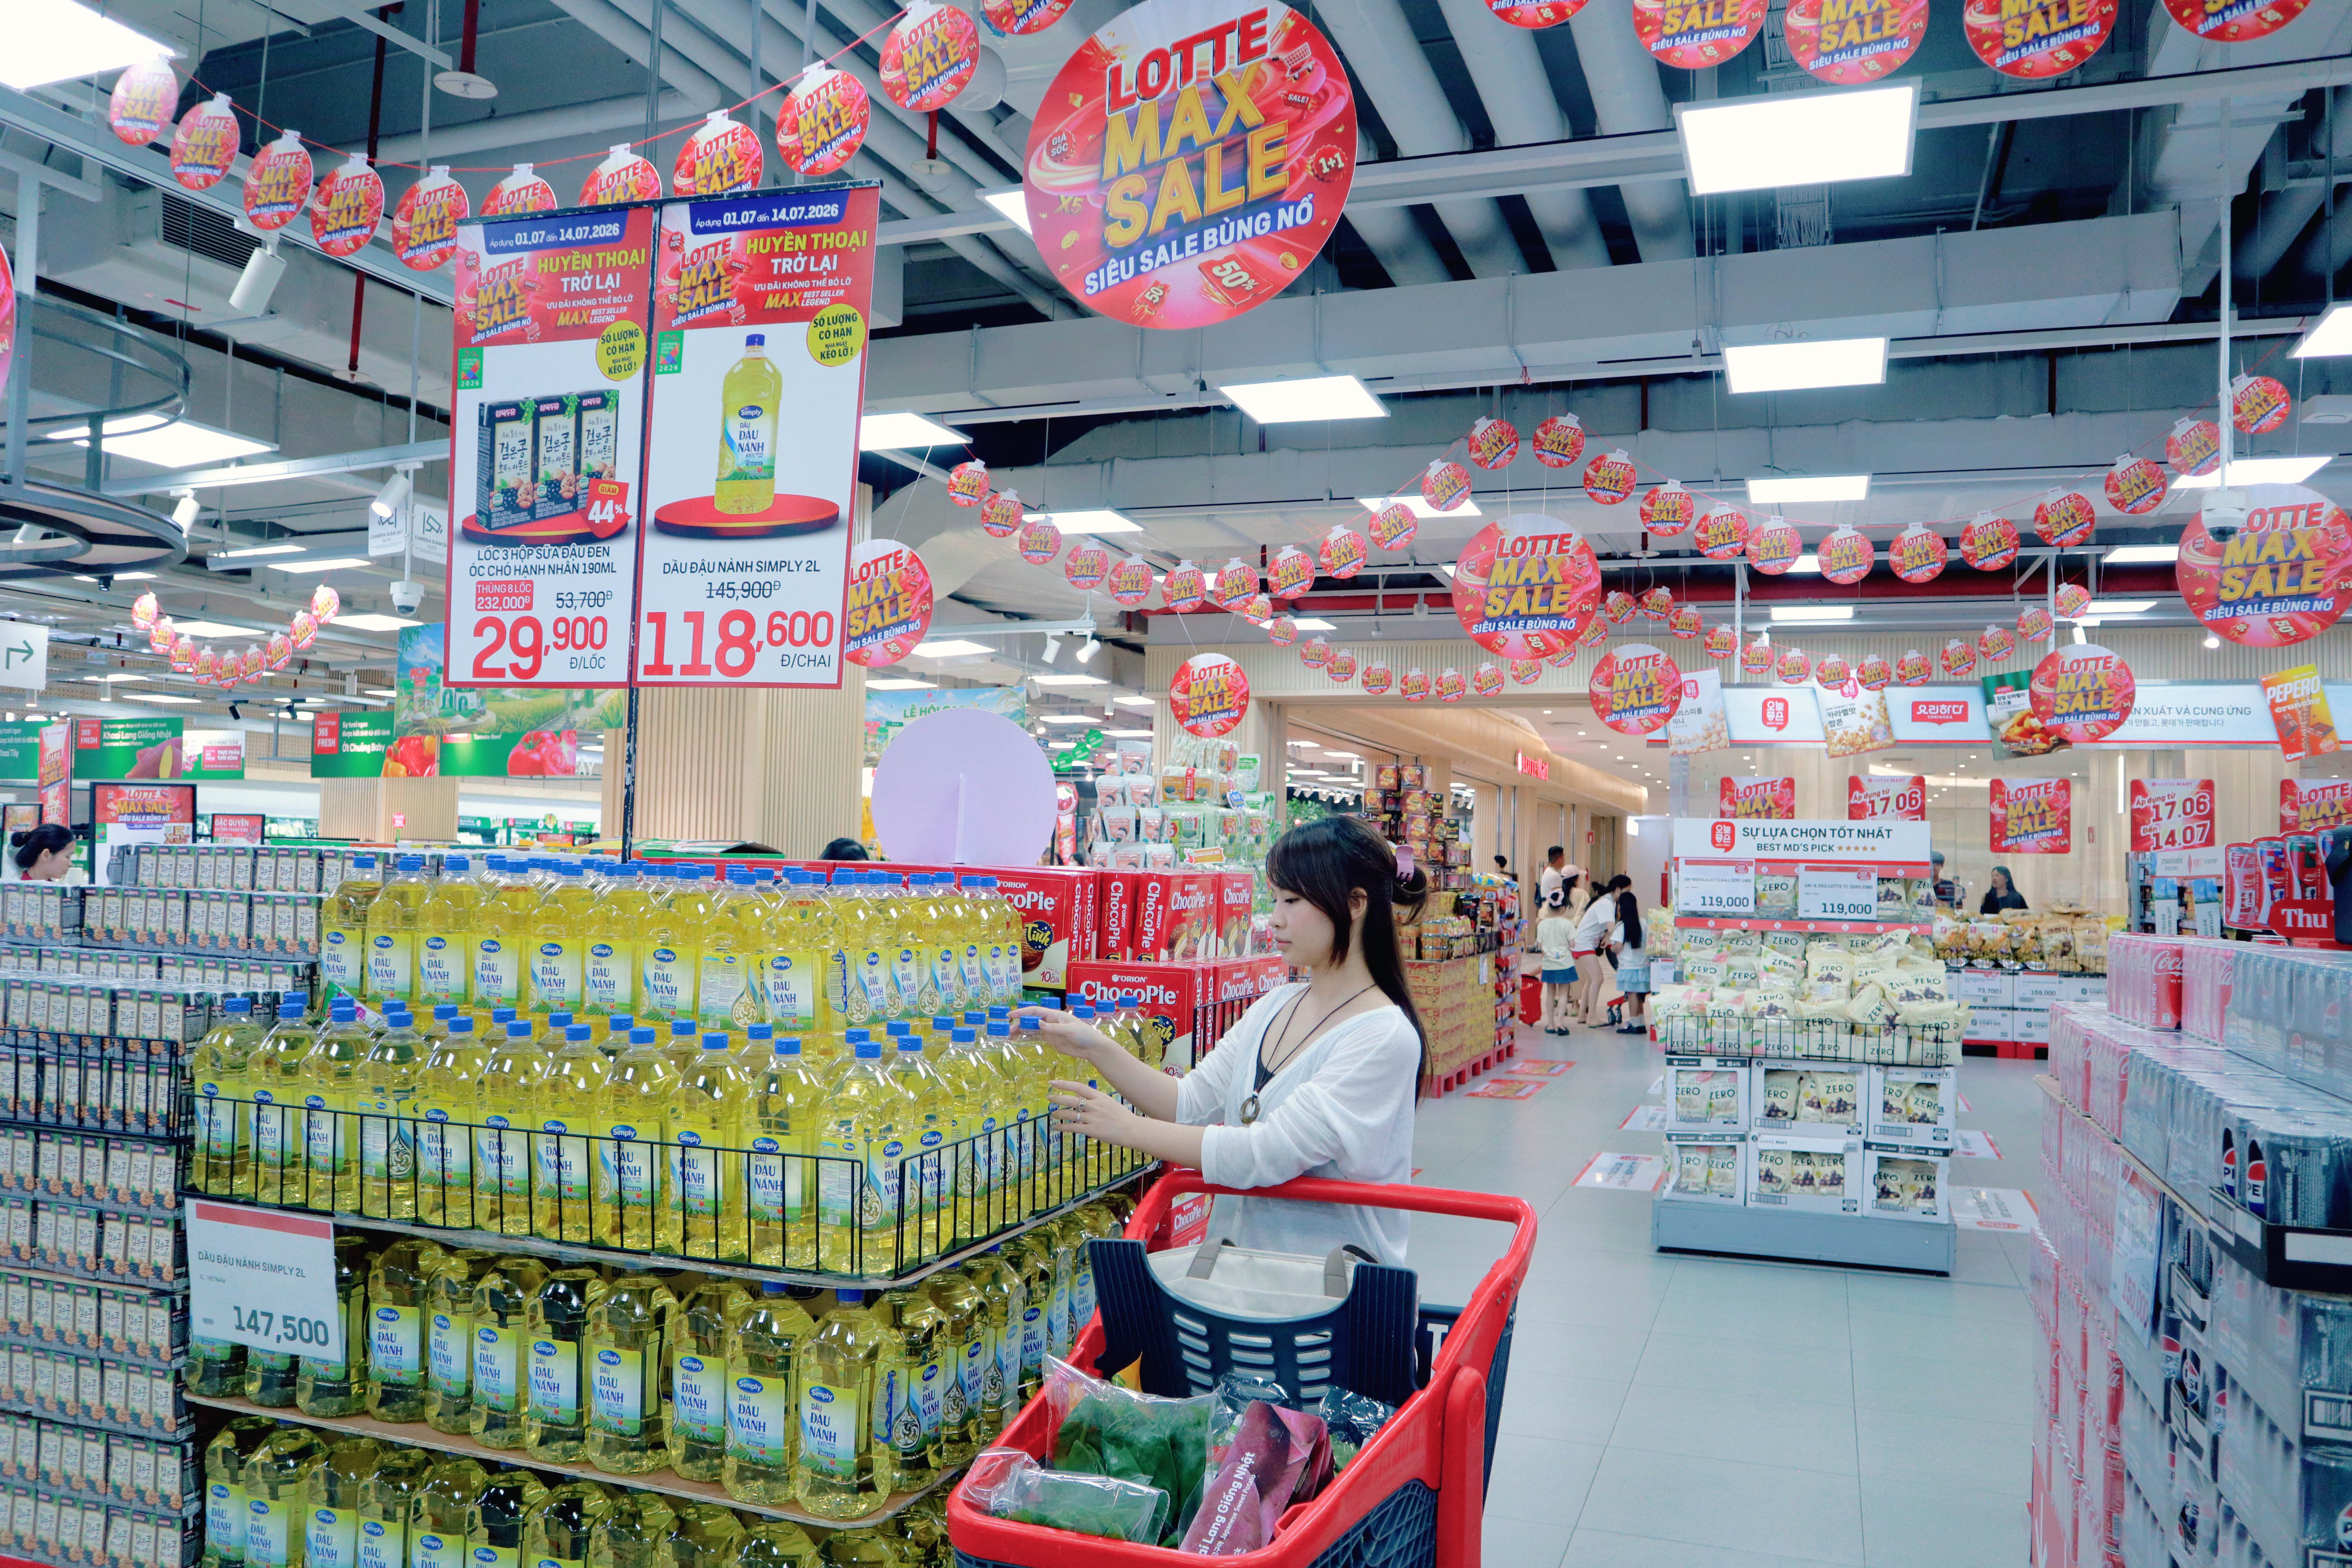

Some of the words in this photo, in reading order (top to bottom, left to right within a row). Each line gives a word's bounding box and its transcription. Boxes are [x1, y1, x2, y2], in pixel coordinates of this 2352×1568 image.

[898, 8, 947, 52] LOTTE
[902, 26, 953, 72] MAX
[907, 38, 961, 93] SALE
[1105, 6, 1270, 115] LOTTE
[1287, 93, 1310, 104] SALE!
[1102, 60, 1265, 181] MAX
[1050, 140, 1069, 156] SỐC
[1052, 132, 1067, 145] GIÁ
[1319, 152, 1344, 173] 1+1
[1104, 120, 1289, 249] SALE
[695, 218, 704, 228] Áp
[705, 218, 721, 227] dụng
[723, 210, 757, 225] 01.07
[757, 213, 769, 222] đến
[771, 203, 839, 221] 14.07.2026
[746, 231, 807, 254] HUYỀN
[811, 230, 867, 252] THOẠI
[1084, 257, 1134, 296] SIÊU
[1140, 236, 1198, 272] SALE
[1203, 216, 1272, 253] BÙNG
[1278, 191, 1314, 230] NỔ
[537, 250, 594, 274] HUYỀN
[596, 248, 646, 269] THOẠI
[680, 237, 732, 270] LOTTE
[771, 252, 807, 274] TRỞ
[809, 255, 837, 276] LẠI
[561, 271, 593, 293] TRỞ
[595, 273, 620, 293] LẠI
[679, 258, 727, 292] MAX
[768, 281, 781, 290] ĐÃI
[782, 278, 809, 289] KHÔNG
[812, 277, 826, 287] THỂ
[828, 277, 839, 287] BỎ
[841, 276, 852, 285] LỠ
[1212, 260, 1259, 292] 50%
[677, 275, 733, 313] SALE
[764, 292, 803, 309] MAX
[801, 298, 830, 307] LEGEND
[813, 314, 825, 328] SỐ
[827, 313, 857, 326] LƯỢNG
[819, 327, 831, 340] CÓ
[833, 327, 852, 339] HẠN
[820, 347, 836, 360] KẺO
[838, 346, 848, 357] LỠ
[740, 408, 761, 416] Simply
[499, 439, 528, 460] 검은콩
[600, 486, 617, 494] GIẢM
[588, 500, 623, 523] 44%
[478, 545, 500, 561] LỐC
[502, 551, 508, 560] 3
[511, 545, 534, 562] HỘP
[536, 544, 559, 559] SỮA
[562, 544, 585, 561] ĐẬU
[588, 546, 610, 557] ĐEN
[1495, 533, 1573, 559] LOTTE
[470, 563, 485, 576] ÓC
[488, 562, 511, 576] CHÓ
[514, 565, 545, 578] HẠNH
[548, 561, 579, 575] NHÂN
[582, 563, 617, 573] 190ML
[663, 559, 687, 574] DẦU
[690, 559, 715, 576] ĐẬU
[719, 558, 753, 573] NÀNH
[756, 560, 802, 572] SIMPLY
[806, 560, 820, 572] 2L
[1489, 555, 1563, 587] MAX
[477, 583, 506, 593] THÙNG
[515, 582, 532, 593] LỐC
[1485, 584, 1573, 618] SALE
[473, 616, 608, 680] 29,900
[644, 609, 833, 677] 118,600
[570, 653, 606, 670] Đ/LỐC
[780, 654, 831, 668] Đ/CHAI
[2267, 675, 2321, 705] PEPERO
[1916, 705, 1964, 716] 요리하다
[2143, 704, 2173, 715] XUẤT
[2176, 705, 2190, 715] VÀ
[2193, 707, 2224, 715] CUNG
[2227, 705, 2251, 715] ỨNG
[2275, 698, 2321, 713] crunchy
[318, 738, 336, 747] FRESH
[371, 742, 385, 753] Baby
[127, 789, 157, 800] LOTTE
[118, 800, 144, 813] MAX
[145, 800, 173, 813] SALE
[2152, 794, 2210, 823] 17.06
[1742, 828, 1760, 839] SỰ
[1764, 827, 1788, 838] LỰA
[1791, 828, 1828, 841] CHỌN
[1830, 826, 1854, 838] TỐT
[1857, 826, 1892, 839] NHẤT
[2152, 821, 2210, 850] 14.07
[1757, 843, 1781, 851] BEST
[1811, 844, 1835, 852] PICK
[1171, 891, 1206, 911] ChocoPie
[1224, 888, 1250, 905] ChocoPie
[1701, 896, 1749, 908] 119,000
[1108, 882, 1123, 948] ChocoPie
[1822, 903, 1871, 915] 119,000
[2281, 908, 2328, 928] Thu
[1041, 971, 1051, 982] 10
[1826, 1084, 1854, 1094] ZERO
[198, 1250, 215, 1263] DẦU
[217, 1254, 234, 1267] ĐẬU
[236, 1257, 260, 1270] NÀNH
[262, 1262, 294, 1276] SIMPLY
[296, 1268, 306, 1278] 2L
[234, 1306, 329, 1347] 147,500
[739, 1380, 762, 1392] Simply
[1202, 1515, 1227, 1544] Lang
[1218, 1481, 1243, 1514] Giống
[1233, 1452, 1256, 1480] Nhật
[1220, 1512, 1238, 1540] Japanese
[1234, 1494, 1247, 1512] Sweet
[1243, 1474, 1256, 1494] Potato
